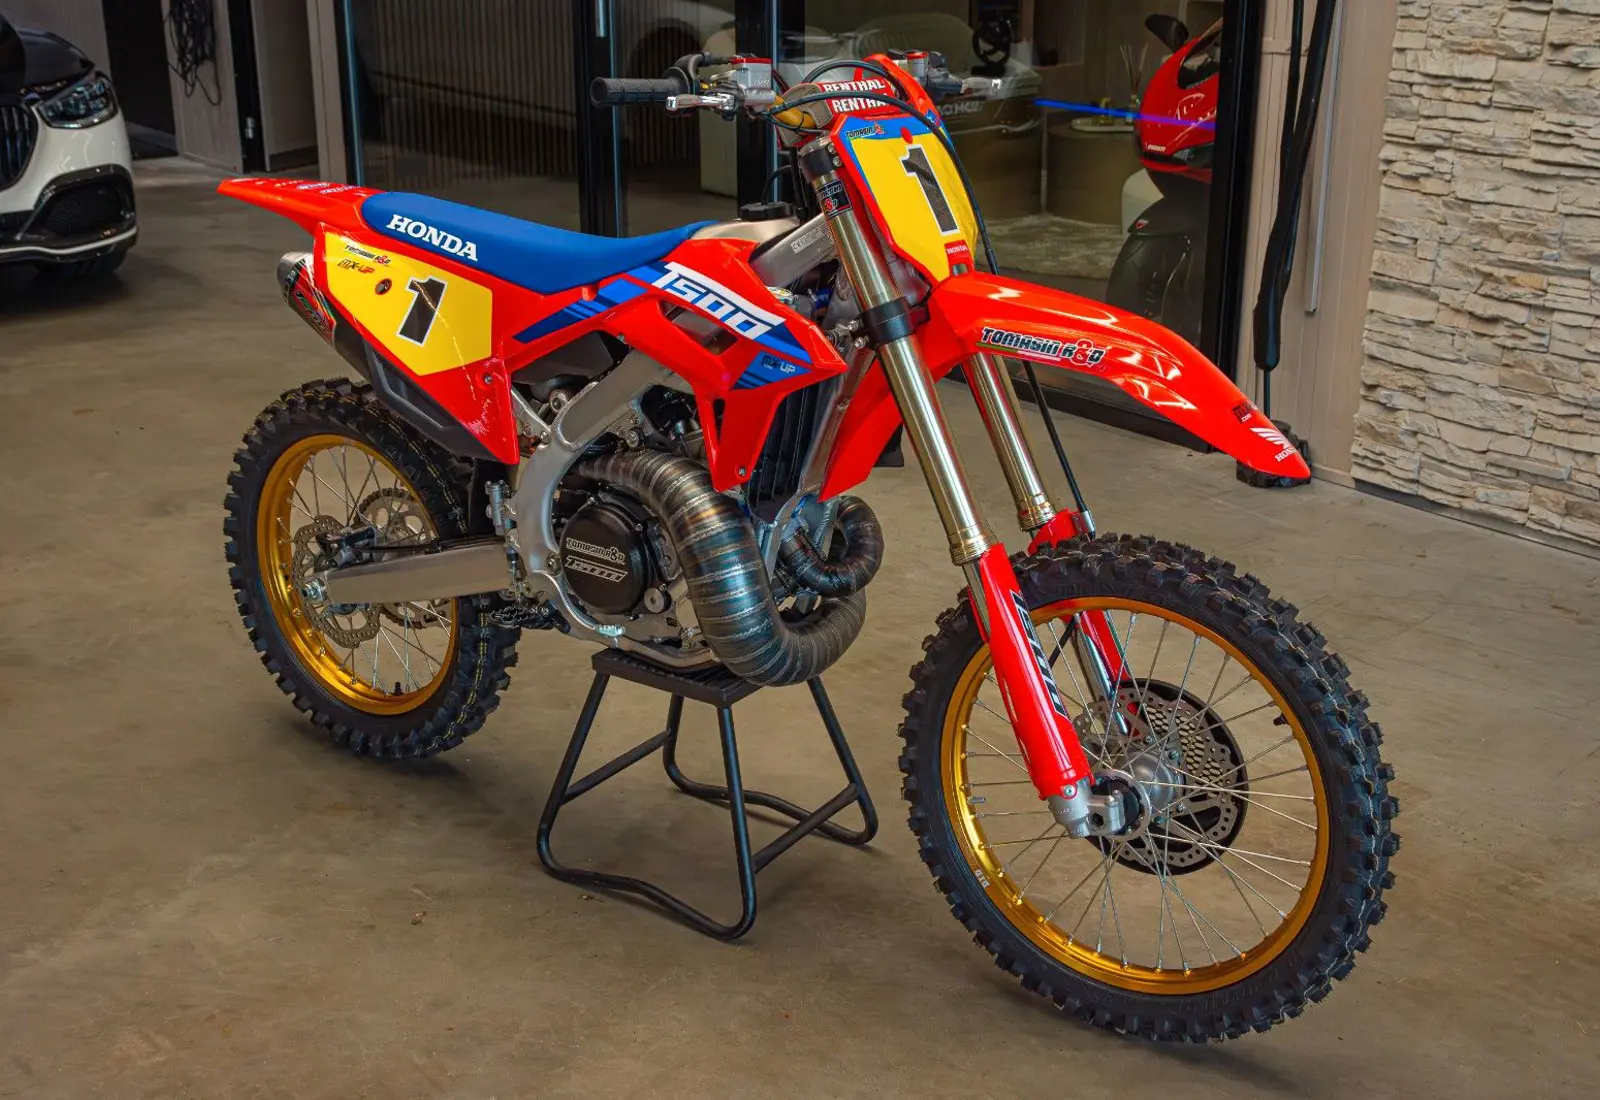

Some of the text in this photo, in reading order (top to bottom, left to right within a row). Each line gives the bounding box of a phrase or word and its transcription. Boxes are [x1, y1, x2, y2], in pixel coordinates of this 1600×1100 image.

[823, 79, 886, 93] RENTHAL
[899, 144, 961, 236] 1
[386, 214, 478, 262] HONDA
[396, 275, 448, 347] 1
[1060, 338, 1106, 367] R&D
